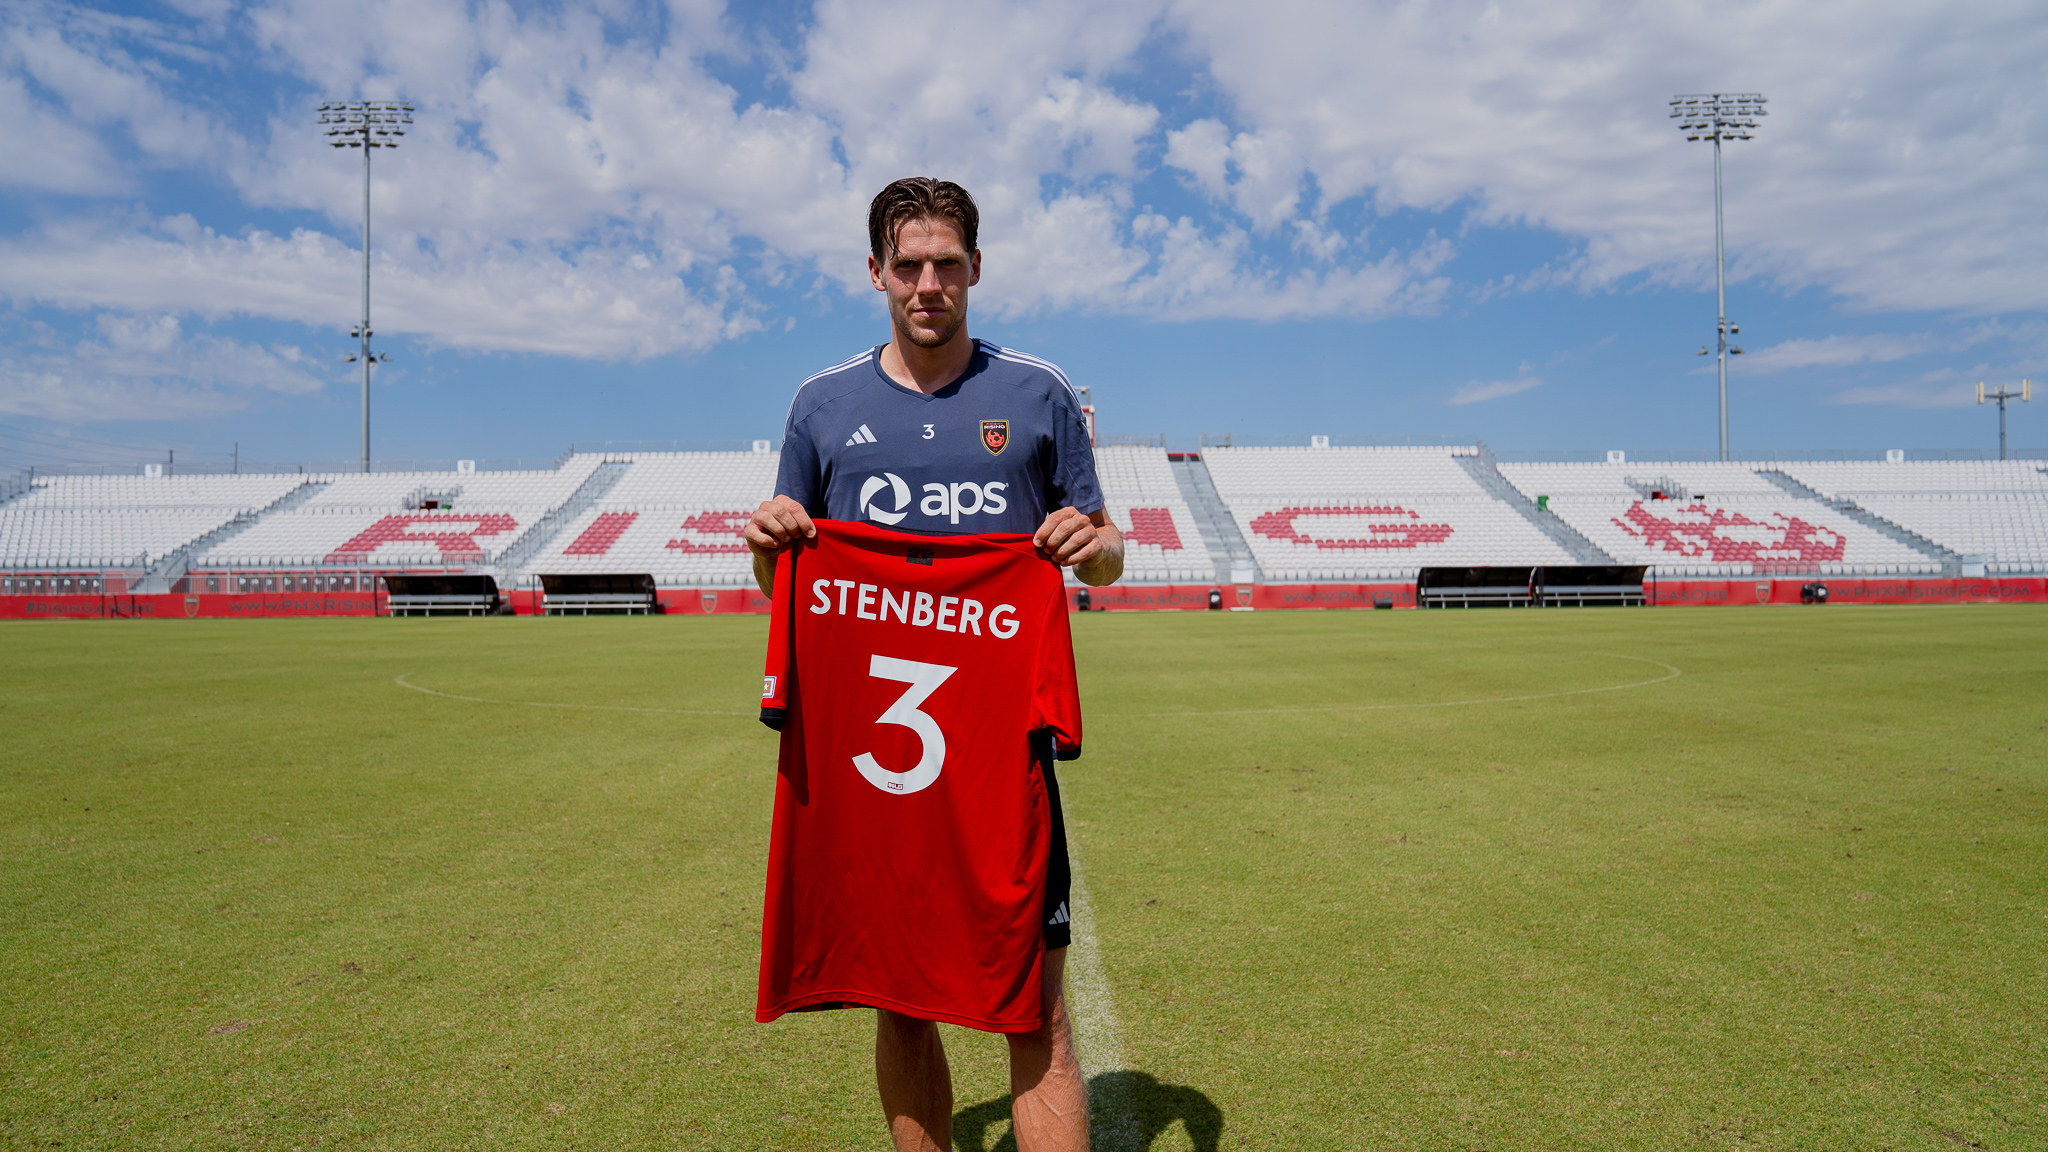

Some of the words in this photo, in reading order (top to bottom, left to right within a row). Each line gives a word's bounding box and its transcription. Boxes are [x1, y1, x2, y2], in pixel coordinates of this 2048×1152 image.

[922, 424, 935, 440] 3
[920, 481, 1008, 525] aps
[810, 578, 1020, 640] STENBERG
[852, 654, 959, 795] 3
